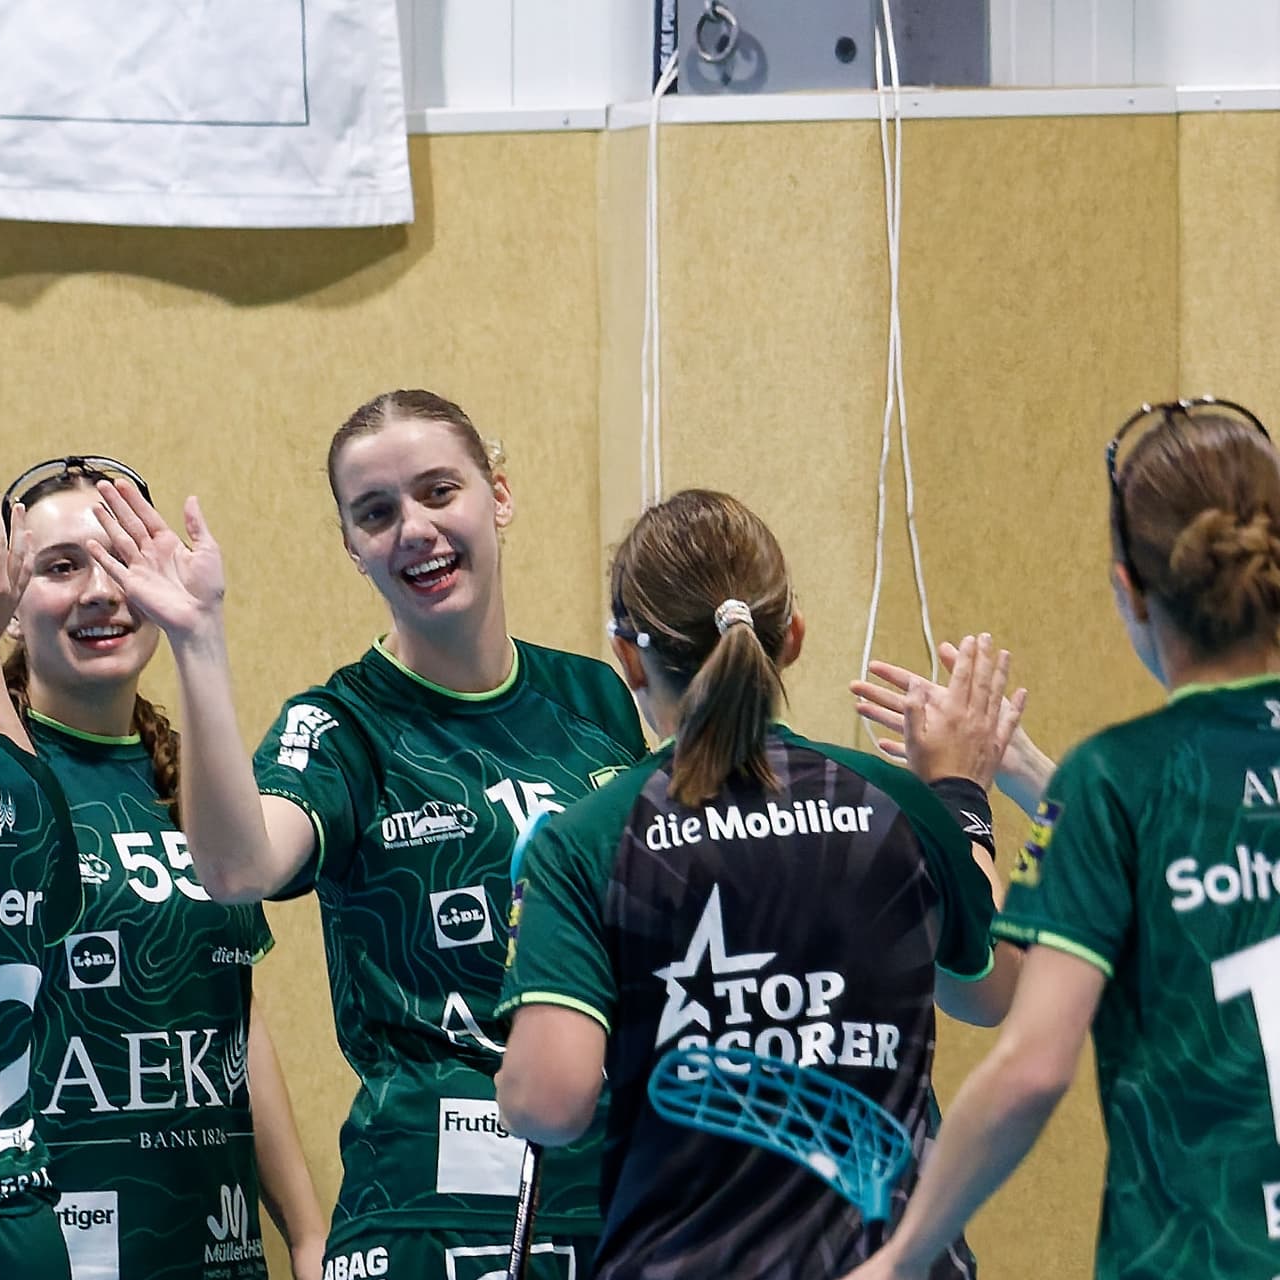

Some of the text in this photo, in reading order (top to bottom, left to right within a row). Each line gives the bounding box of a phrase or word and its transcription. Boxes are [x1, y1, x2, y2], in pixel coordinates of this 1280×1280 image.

[645, 798, 874, 852] die Mobiliar
[1165, 845, 1280, 912] Solt
[713, 970, 846, 1025] TOP
[40, 1028, 225, 1115] AEK
[676, 1021, 901, 1082] SCORER
[140, 1129, 197, 1149] BANK
[57, 1205, 115, 1231] tiger
